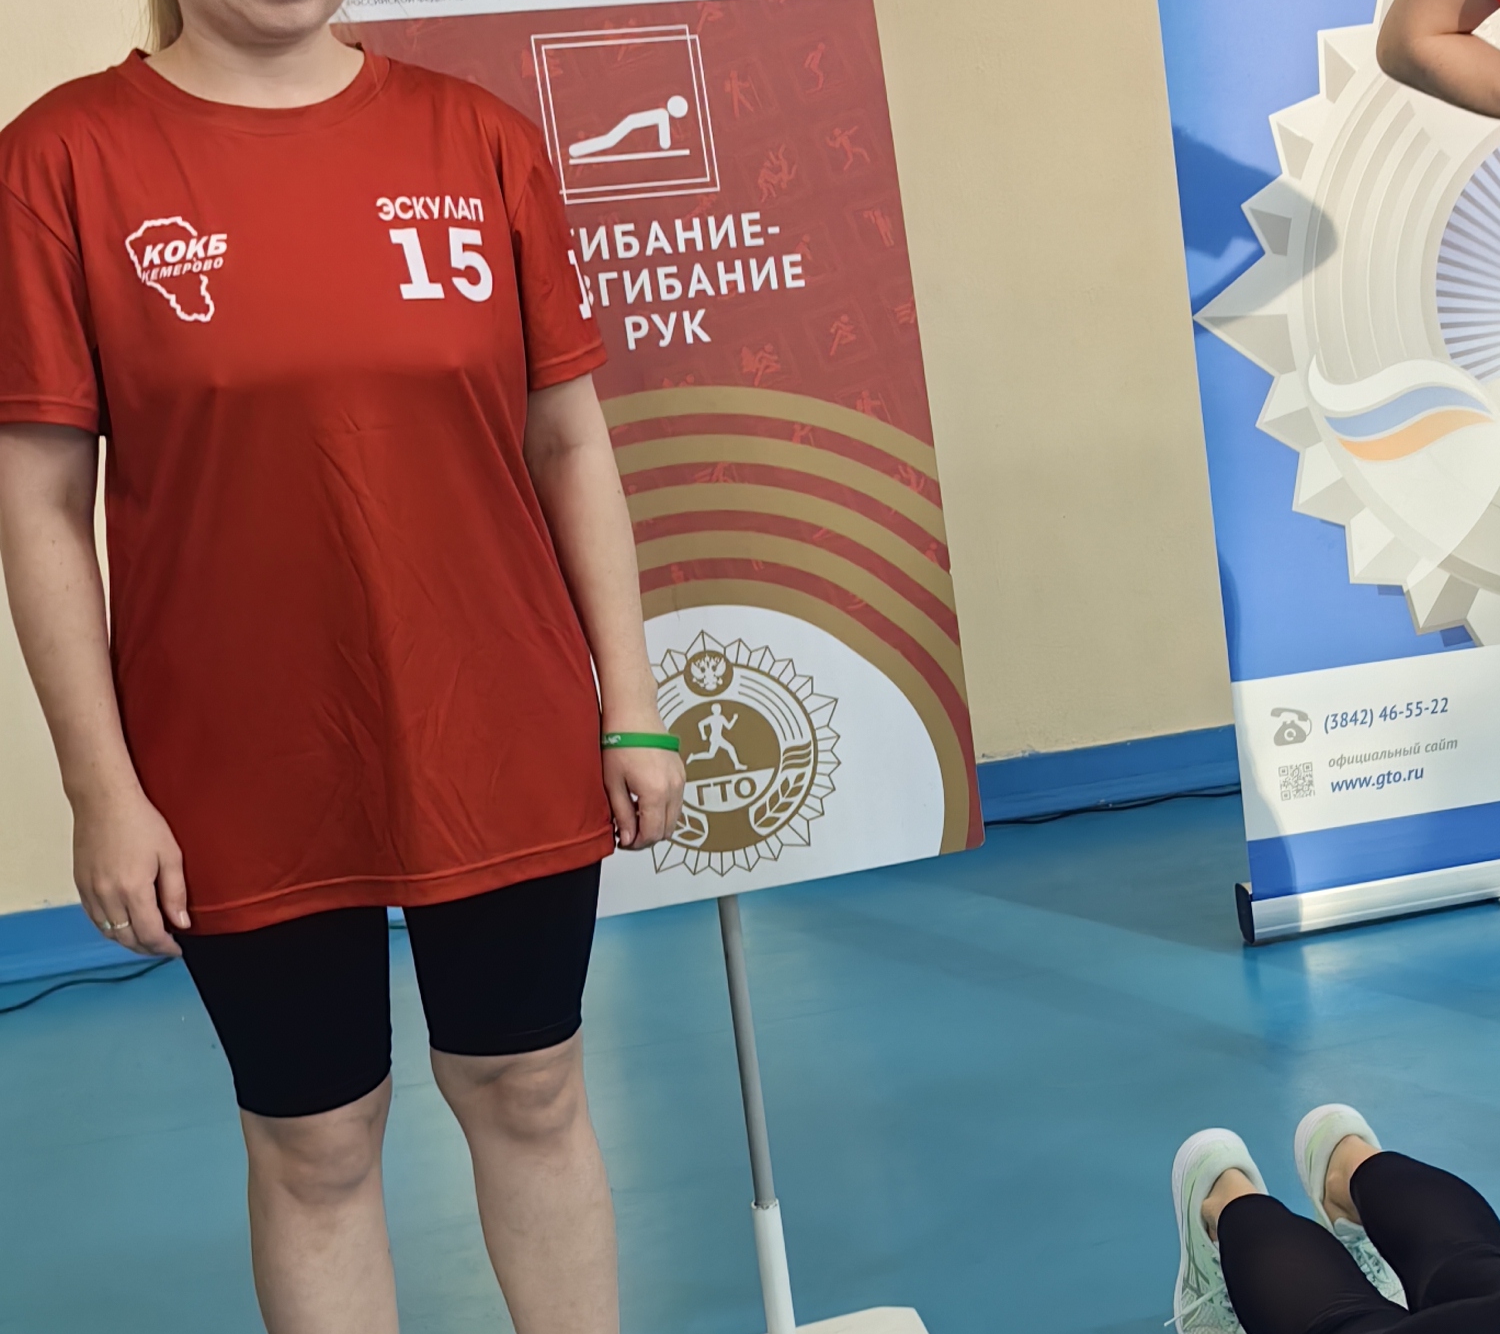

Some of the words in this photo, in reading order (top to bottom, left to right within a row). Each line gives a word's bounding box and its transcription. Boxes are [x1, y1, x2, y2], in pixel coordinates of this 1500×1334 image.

[376, 195, 485, 222] ЭСКУЛАП
[142, 233, 228, 268] КОКБ
[570, 211, 780, 263] ИБАНИЕ-
[141, 256, 224, 284] КЕМЕРОВО
[388, 226, 493, 303] 15
[624, 309, 712, 351] РУК
[1323, 708, 1374, 735] (3842)
[1378, 696, 1449, 722] 46-55-22
[1328, 741, 1421, 770] официальный
[1424, 737, 1459, 754] сайт
[696, 777, 758, 807] ГТО
[1330, 767, 1424, 793] www.gto.ru
